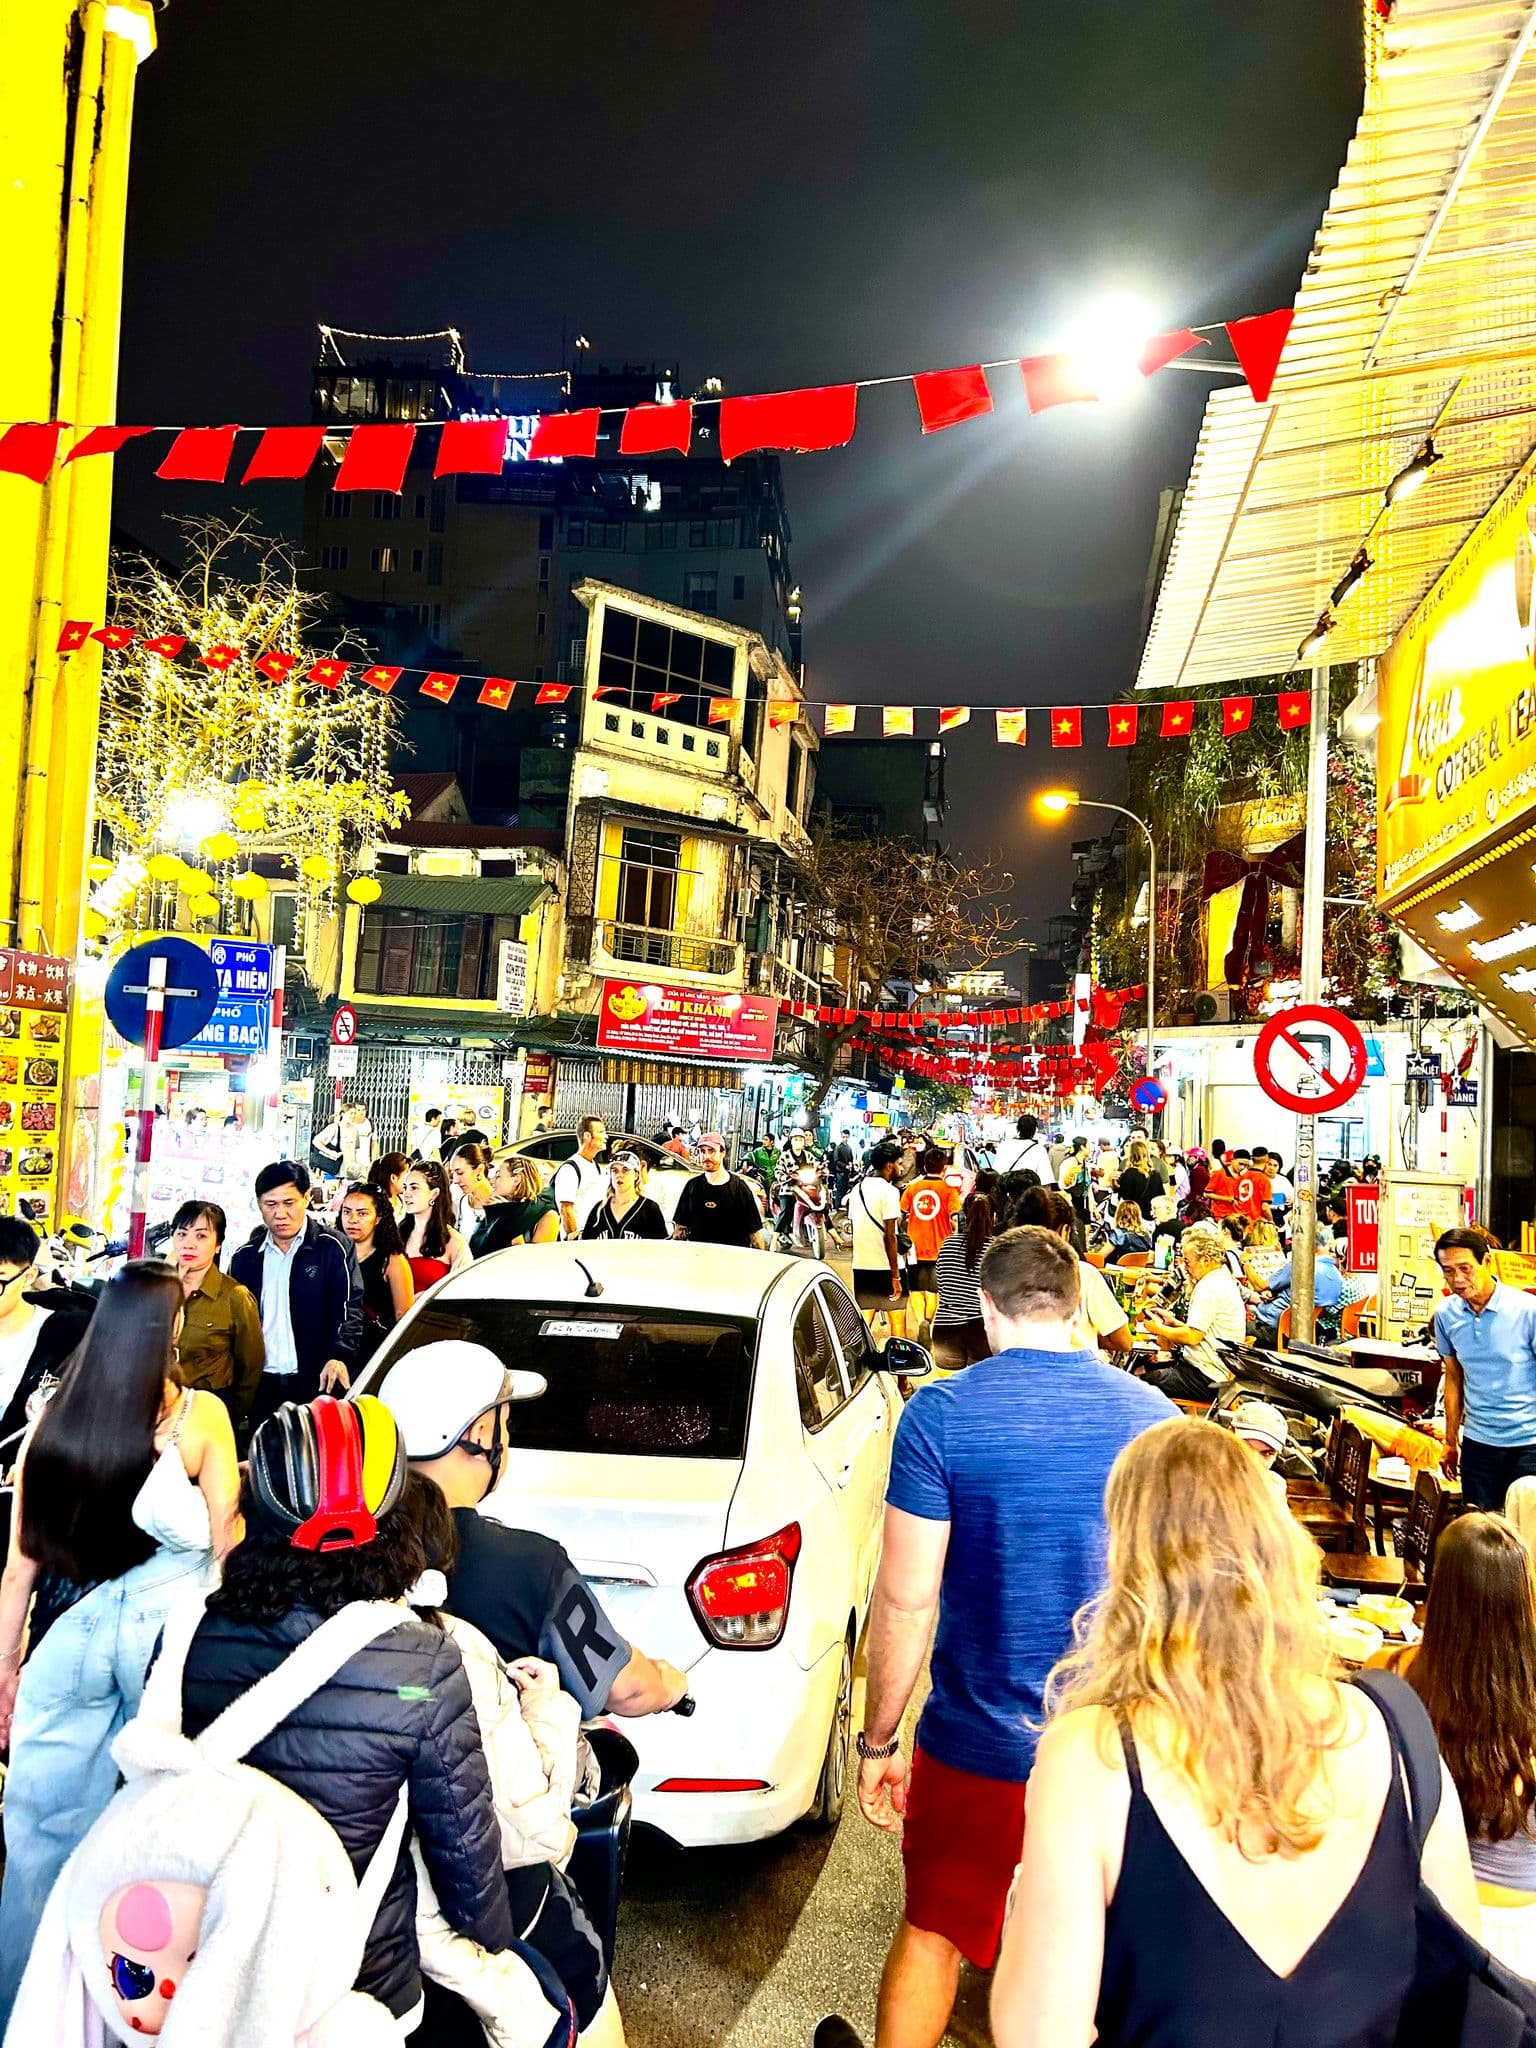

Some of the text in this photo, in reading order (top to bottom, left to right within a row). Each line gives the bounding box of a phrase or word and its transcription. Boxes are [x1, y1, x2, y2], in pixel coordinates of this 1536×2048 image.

[1435, 724, 1487, 802] COFFEE
[235, 949, 257, 963] PHỐ
[235, 966, 268, 993] HIỆN
[212, 1004, 243, 1018] PHỐ
[228, 1025, 260, 1048] BẠC
[551, 1583, 617, 1693] R
